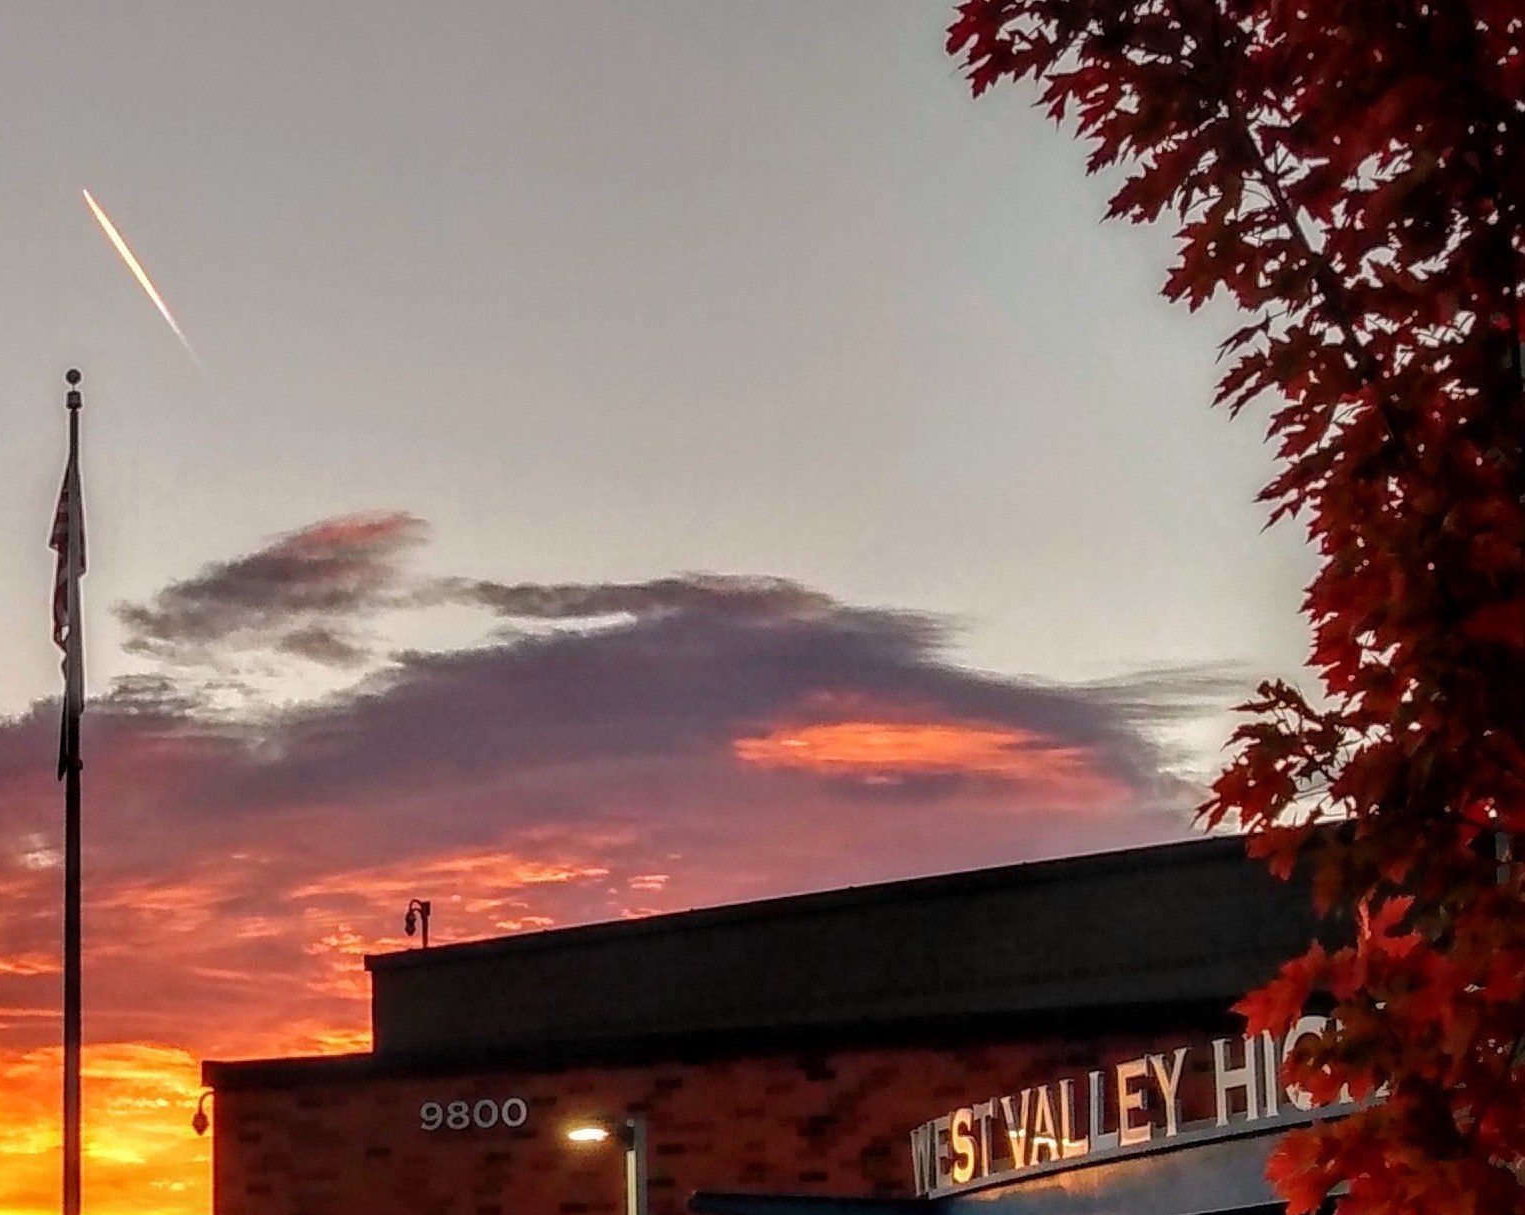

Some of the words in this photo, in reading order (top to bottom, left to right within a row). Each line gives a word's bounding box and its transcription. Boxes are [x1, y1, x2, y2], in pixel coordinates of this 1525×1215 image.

[420, 1097, 528, 1131] 9800
[909, 1097, 997, 1198] WEST
[1000, 1047, 1189, 1171] VALLEY
[1212, 1015, 1391, 1128] HI
